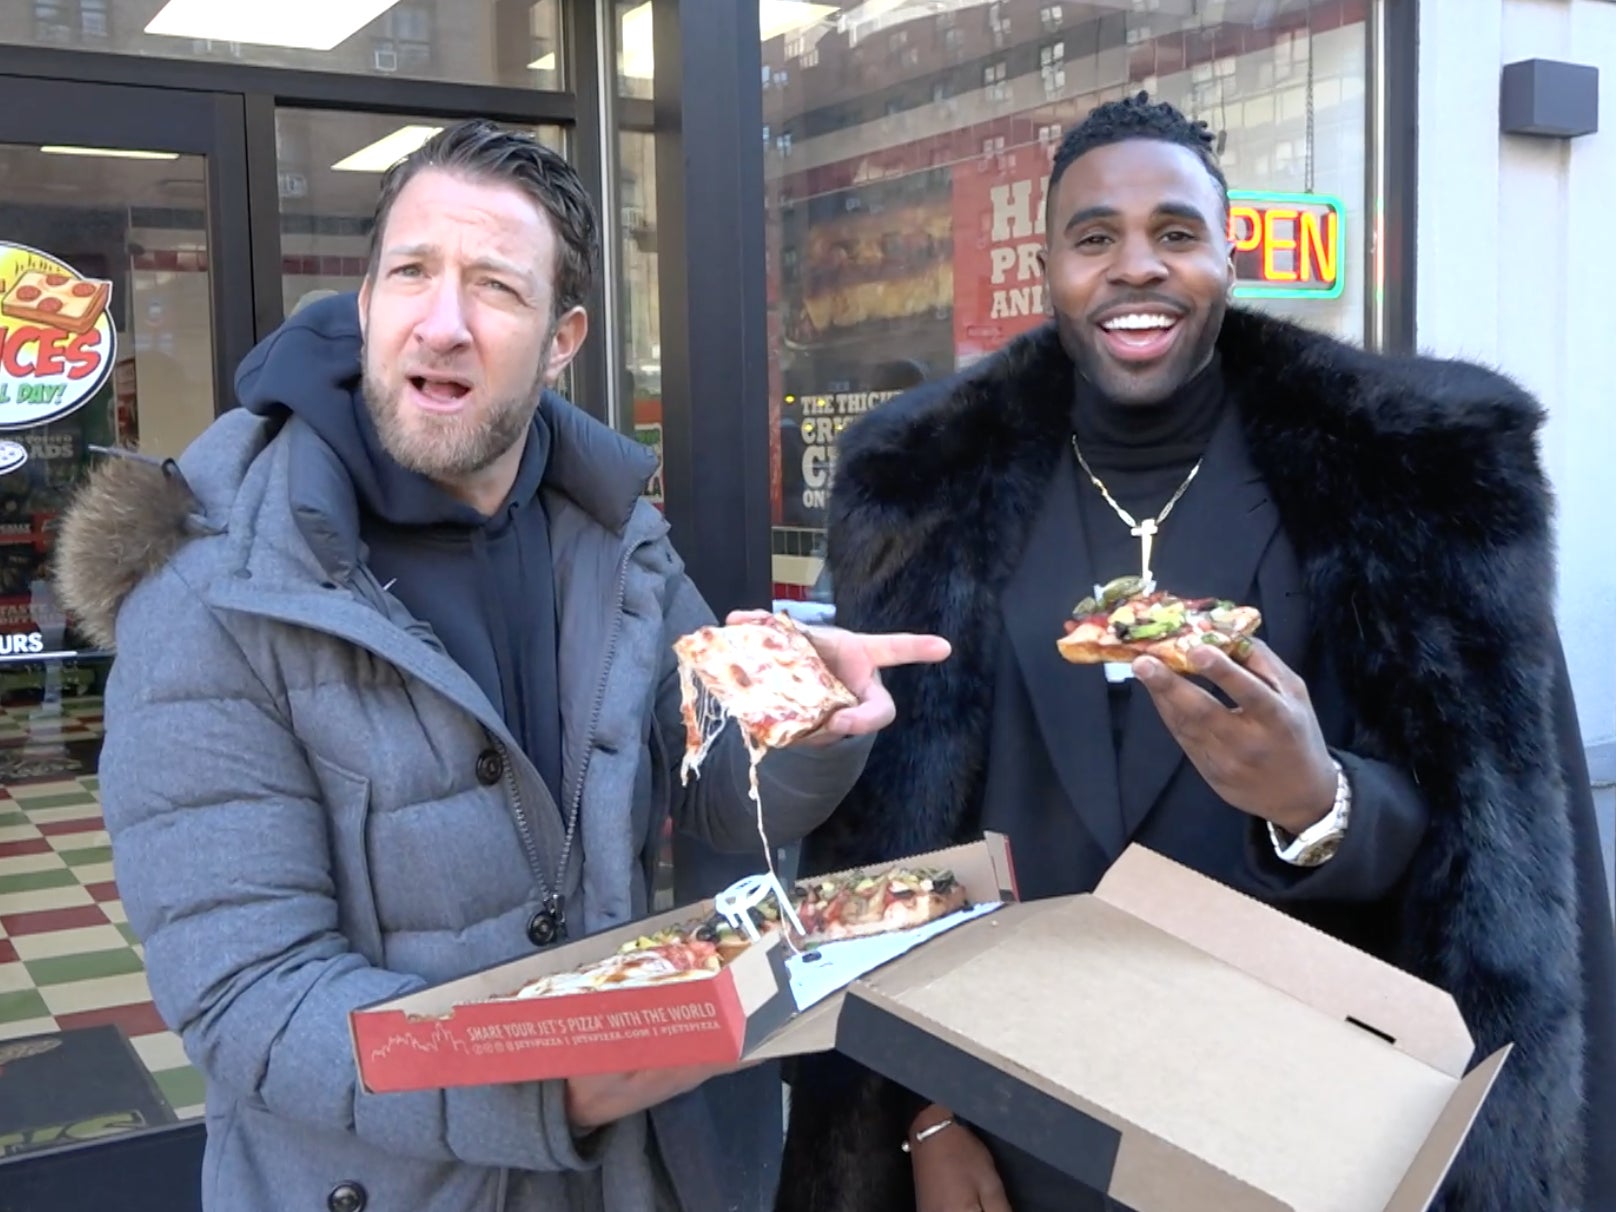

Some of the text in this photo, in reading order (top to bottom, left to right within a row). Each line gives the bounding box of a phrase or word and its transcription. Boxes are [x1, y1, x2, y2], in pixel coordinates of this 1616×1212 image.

[16, 383, 67, 405] DAY!
[800, 393, 835, 415] THE
[466, 1025, 504, 1041] SHARE
[503, 1021, 537, 1038] YOUR
[607, 1010, 642, 1028] WITH
[641, 1007, 668, 1024] THE
[668, 1002, 717, 1021] WORLD
